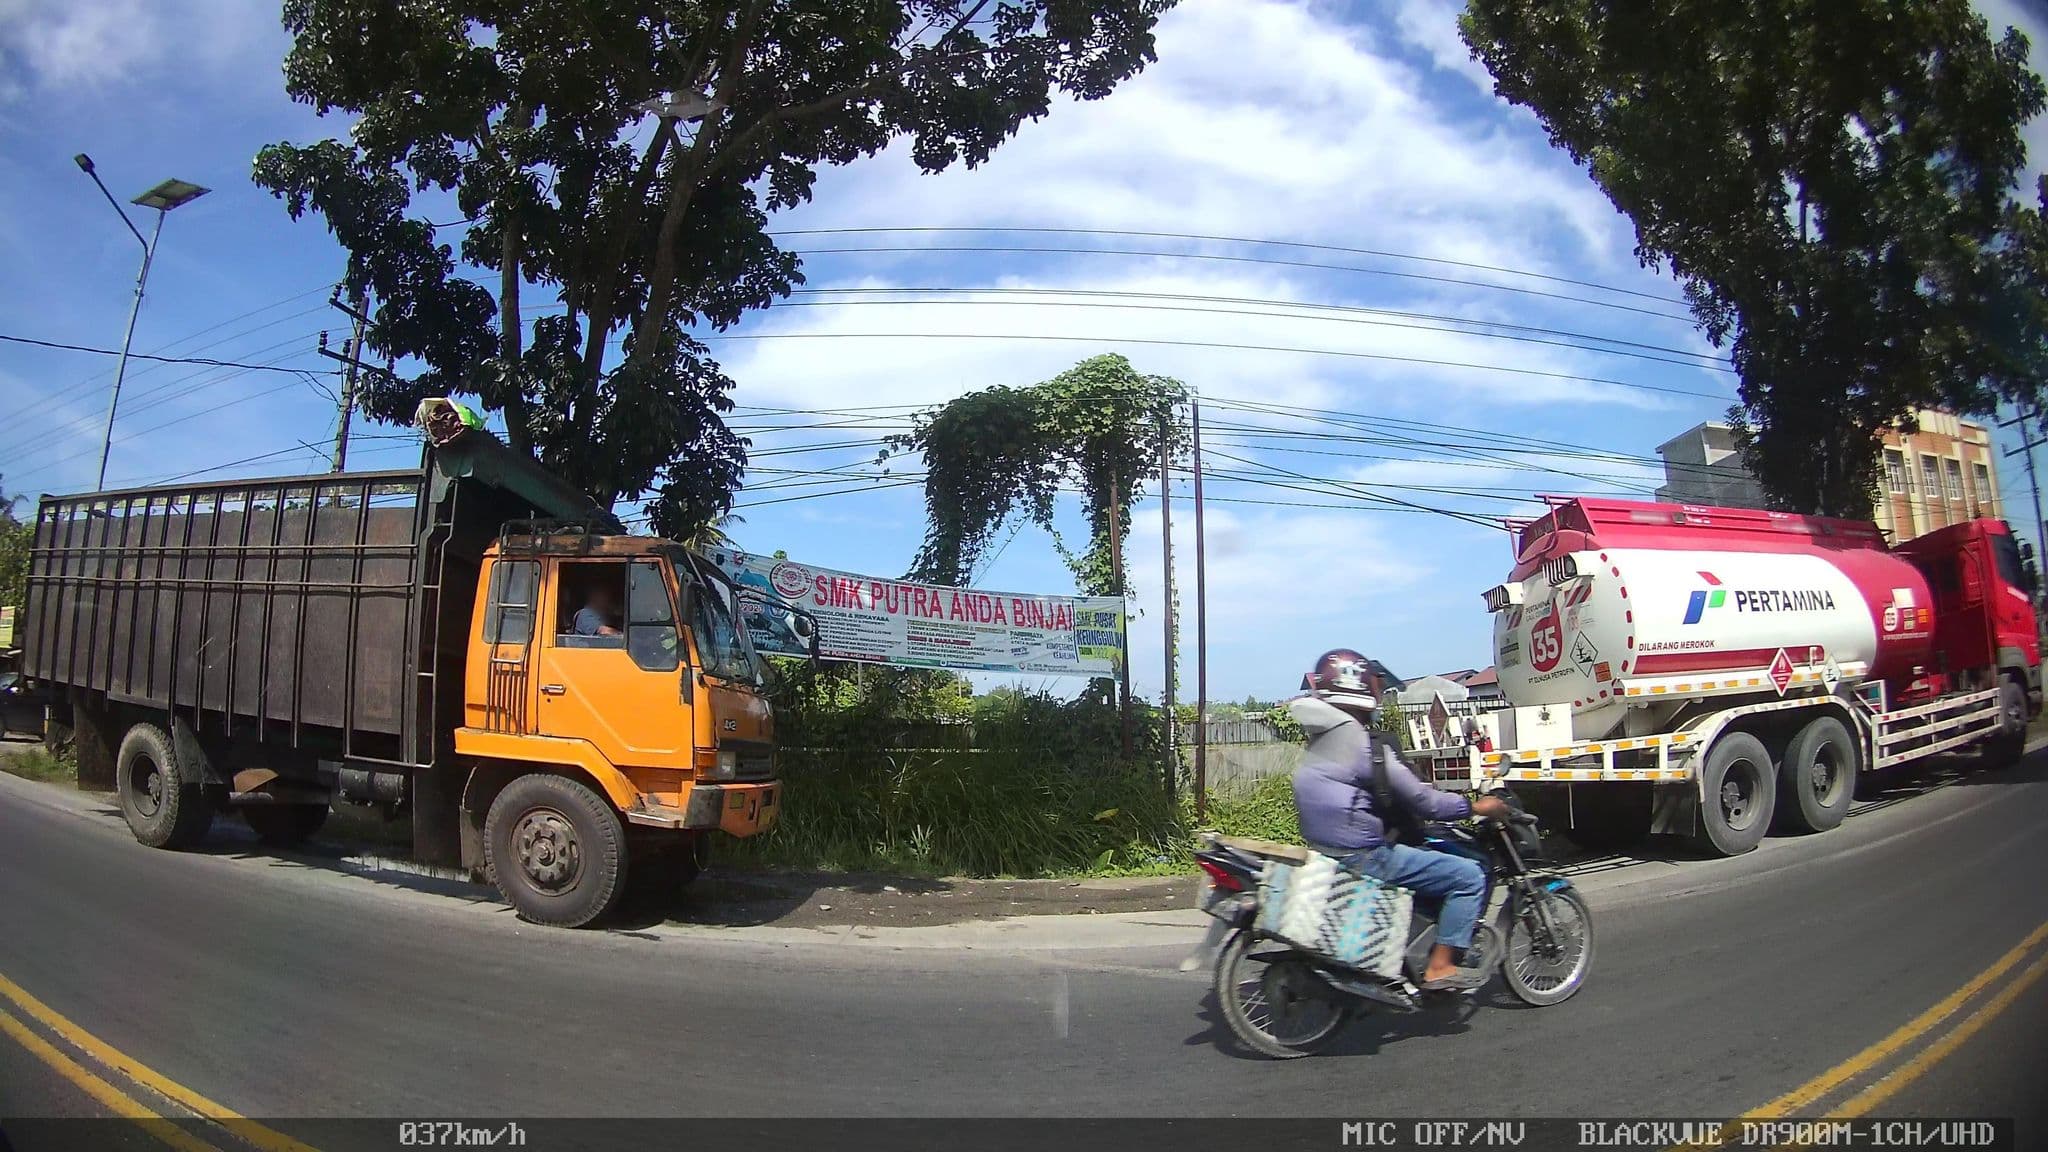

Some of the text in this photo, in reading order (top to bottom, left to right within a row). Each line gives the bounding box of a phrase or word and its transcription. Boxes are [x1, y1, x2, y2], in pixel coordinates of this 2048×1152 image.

[814, 575, 863, 610] SMK
[871, 582, 943, 619] PUTRA
[950, 592, 1007, 625] ANDA
[1013, 598, 1073, 632] BINJAI
[1734, 589, 1836, 613] PERTAMINA
[1095, 611, 1117, 629] PUSAT
[1076, 629, 1122, 649] KEUNGGULN
[1529, 625, 1559, 665] 135
[1638, 639, 1715, 652] DILARANG MEROKOK
[1551, 667, 1575, 679] PETROFIN
